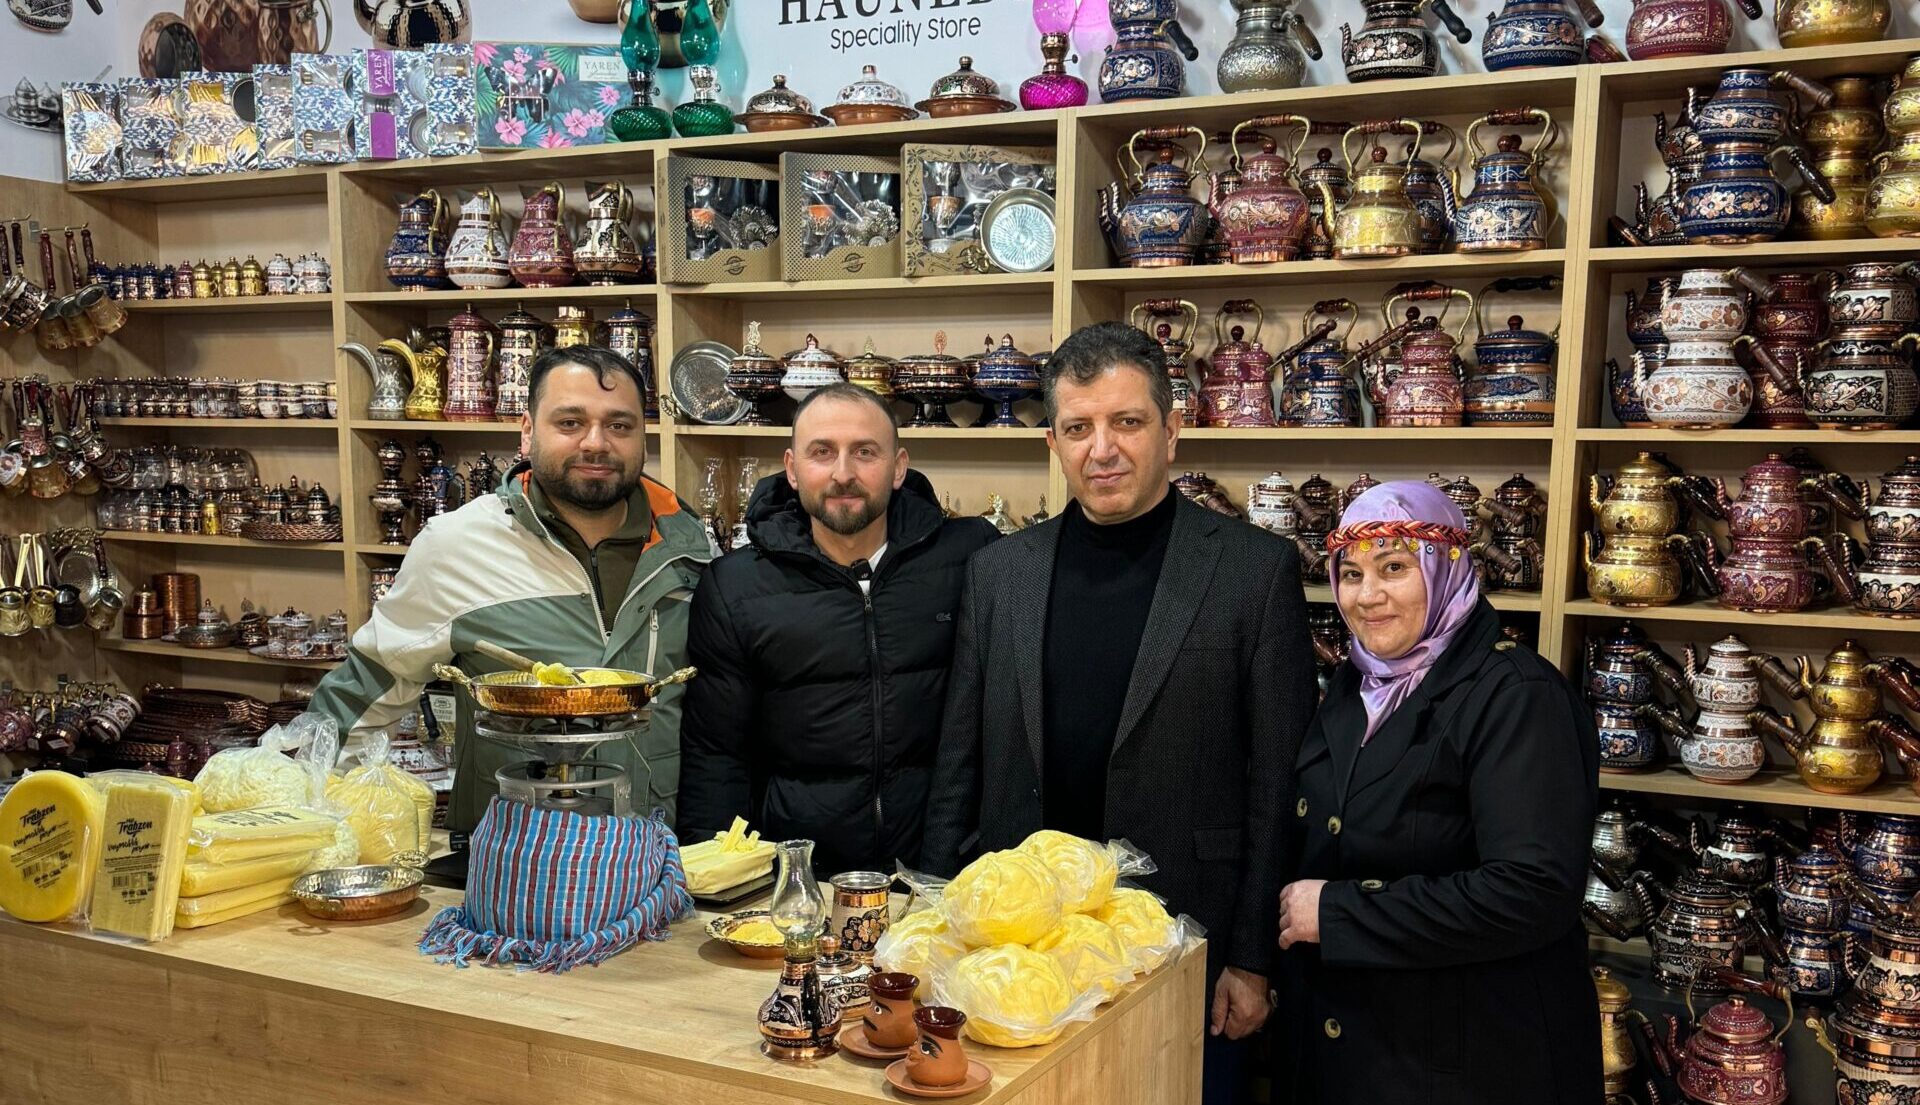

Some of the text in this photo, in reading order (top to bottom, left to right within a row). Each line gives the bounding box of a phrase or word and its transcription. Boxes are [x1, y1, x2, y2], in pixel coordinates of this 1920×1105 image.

[830, 16, 982, 53] Speciality Store
[374, 55, 384, 89] YAREN
[584, 61, 621, 71] YAREN
[20, 805, 56, 827] Trabzon
[117, 820, 153, 837] Trabzon
